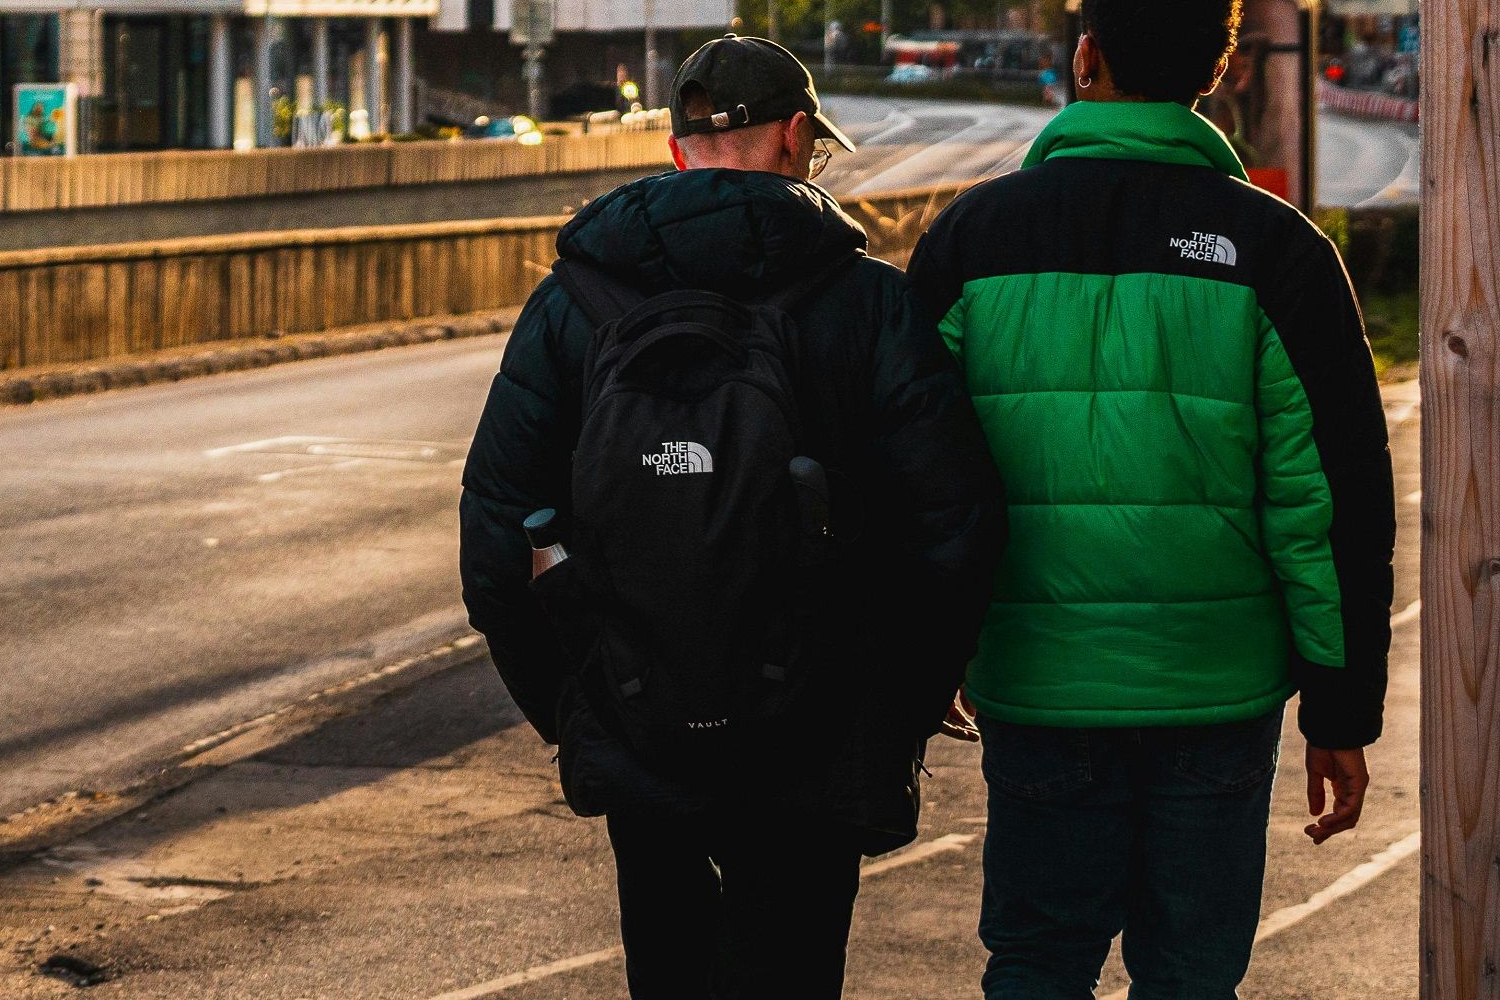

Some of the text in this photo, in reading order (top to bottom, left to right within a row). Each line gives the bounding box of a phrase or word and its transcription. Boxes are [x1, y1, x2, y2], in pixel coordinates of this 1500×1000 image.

[1191, 231, 1216, 244] THE
[1169, 238, 1215, 253] NORTH
[1180, 249, 1213, 262] FACE
[661, 441, 687, 453] THE
[642, 453, 687, 466] NORTH
[656, 463, 688, 476] FACE
[688, 718, 727, 728] VAULT
